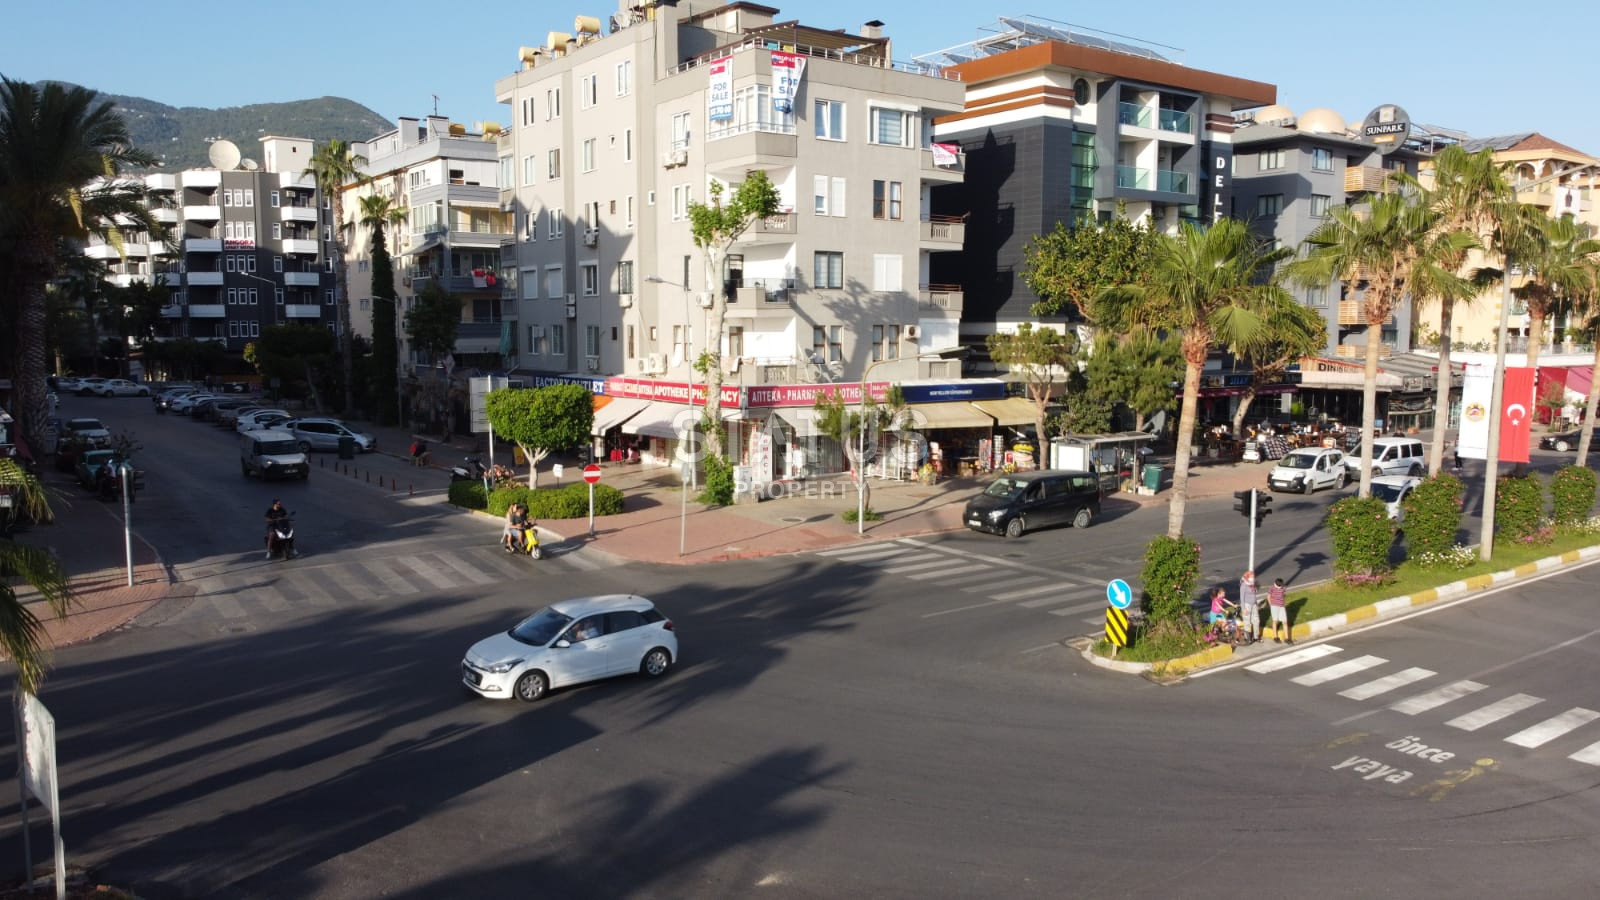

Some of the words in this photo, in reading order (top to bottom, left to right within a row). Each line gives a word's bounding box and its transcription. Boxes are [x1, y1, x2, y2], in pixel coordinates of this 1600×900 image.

[713, 82, 727, 91] FOR
[781, 77, 798, 86] FOR
[712, 91, 728, 102] SALE
[1366, 124, 1403, 135] SUNPARK
[535, 376, 570, 388] FACTORY
[654, 383, 689, 398] APOTHEKE
[691, 388, 738, 402] PHACY
[787, 388, 825, 401] PHARMA
[1331, 755, 1414, 784] yaya
